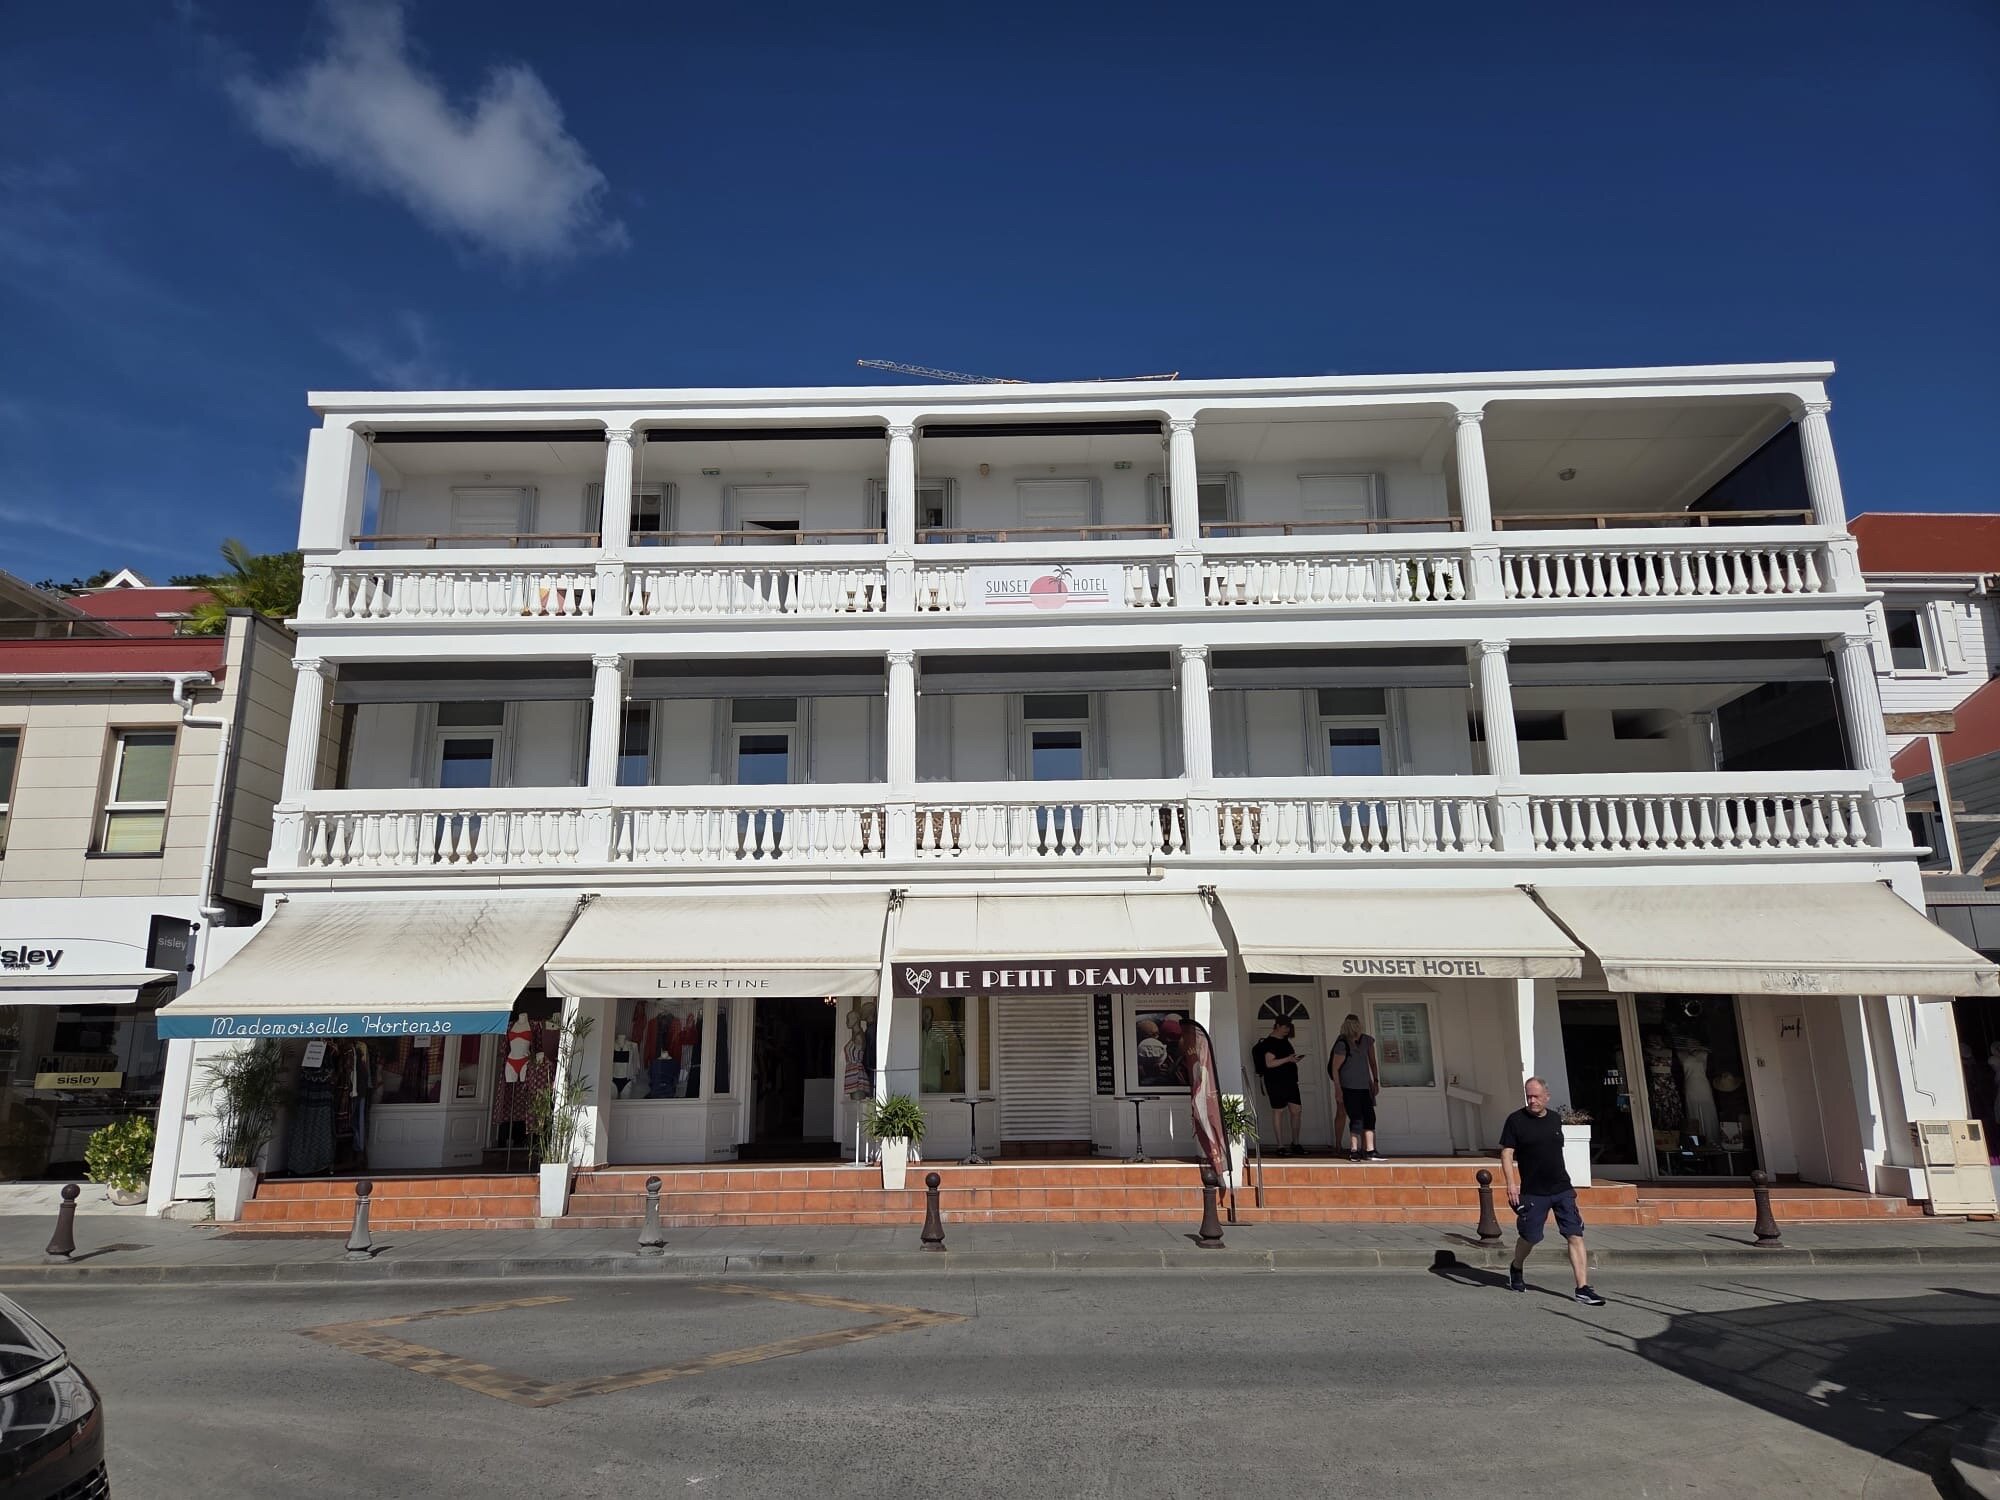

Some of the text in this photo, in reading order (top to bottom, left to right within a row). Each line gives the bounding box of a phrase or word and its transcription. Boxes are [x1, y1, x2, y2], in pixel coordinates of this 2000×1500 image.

[986, 578, 1108, 593] SUNSET HOTEL
[158, 937, 187, 951] sisley
[0, 945, 65, 970] sley
[1342, 959, 1486, 976] SUNSET HOTEL
[657, 979, 769, 989] LIBERTINE
[940, 966, 1212, 989] LE PETIT DEAUVILLE
[210, 1015, 452, 1036] Mademoiselle Hortense
[57, 1074, 100, 1086] sisley
